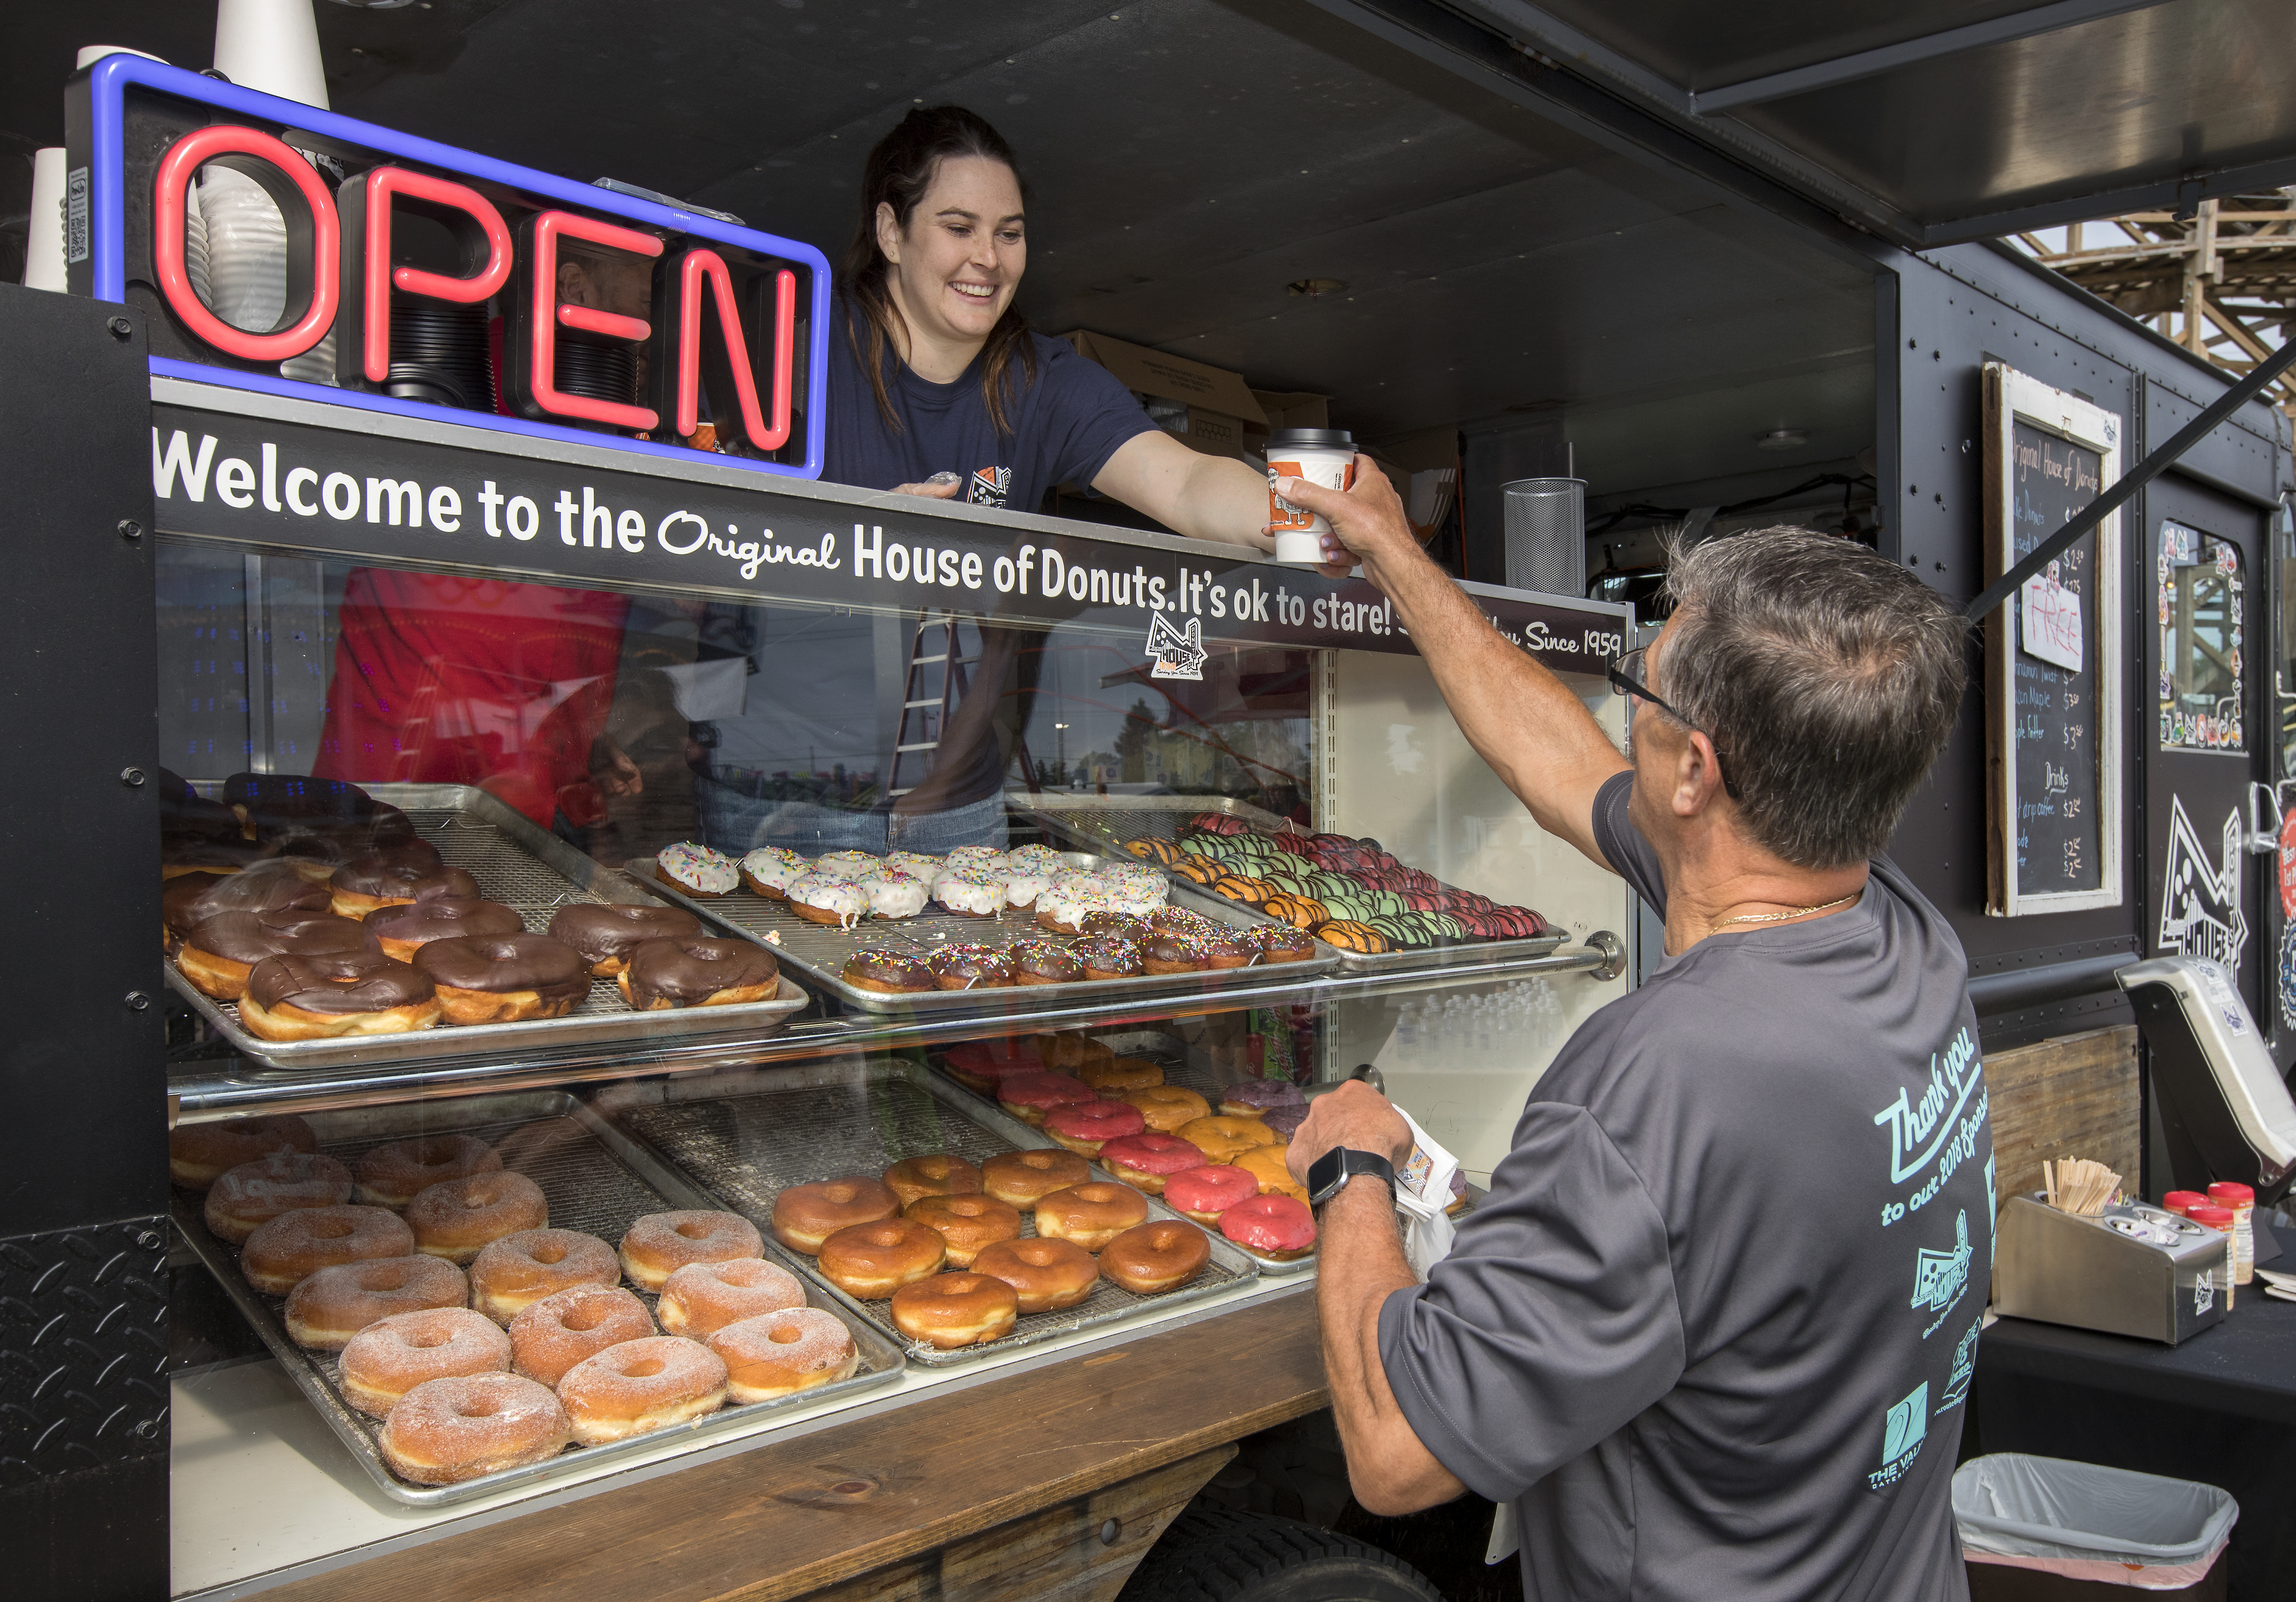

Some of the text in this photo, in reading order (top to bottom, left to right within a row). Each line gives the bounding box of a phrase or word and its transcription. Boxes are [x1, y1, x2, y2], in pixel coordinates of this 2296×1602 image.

[156, 125, 796, 451] OPEN
[2044, 442, 2062, 480] House
[2064, 449, 2074, 487] of
[153, 427, 461, 532] Welcome
[478, 480, 539, 540] to
[555, 487, 645, 552] the
[657, 510, 841, 580] Original
[854, 524, 983, 589] House
[994, 545, 1036, 595] of
[1234, 578, 1271, 626] ok
[1276, 586, 1305, 626] to
[1313, 592, 1391, 635] stare!
[1526, 621, 1579, 653] Since
[1584, 630, 1621, 658] 1959
[2031, 584, 2079, 656] FREE
[1162, 647, 1191, 667] HOUSE
[2029, 686, 2051, 712] Maple
[2045, 761, 2069, 790] Drinks
[1874, 1027, 1975, 1177] Thank you
[1881, 1203, 1905, 1227] to
[1910, 1175, 1939, 1212] our
[1939, 1135, 1962, 1186] 2018
[1911, 1286, 1935, 1305] Original
[1868, 1463, 1898, 1484] THE
